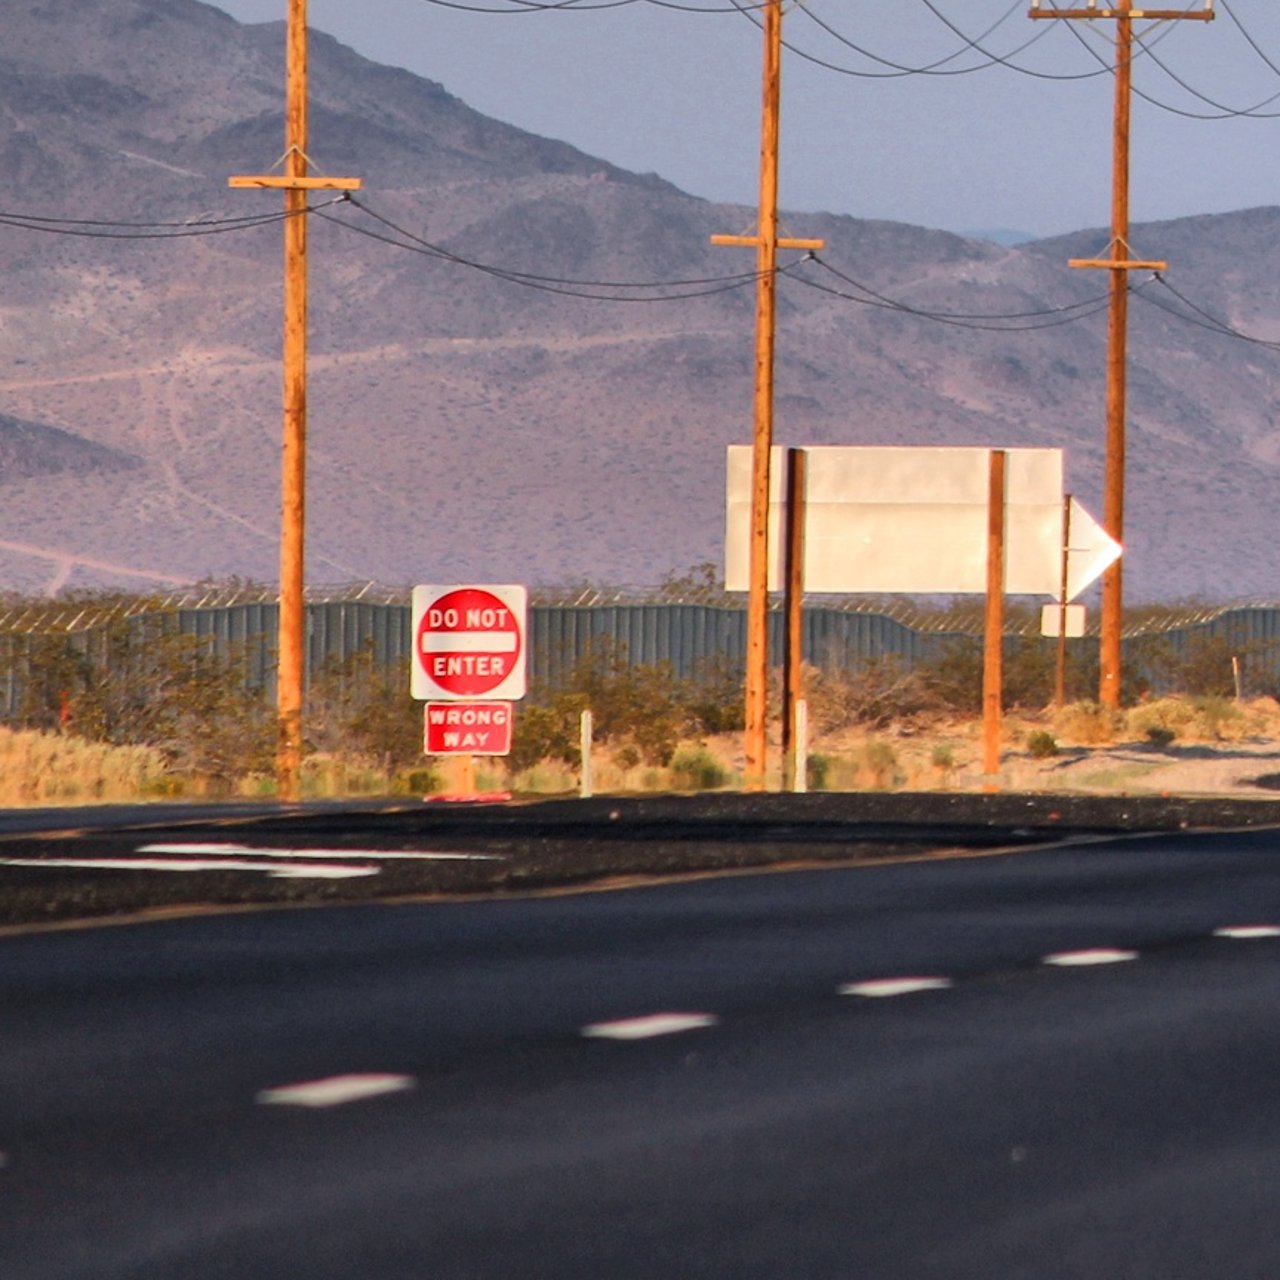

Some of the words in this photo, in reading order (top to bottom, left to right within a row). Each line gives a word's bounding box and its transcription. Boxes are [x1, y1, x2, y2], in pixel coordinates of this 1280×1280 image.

[429, 608, 459, 628] DO
[466, 608, 509, 628] NOT
[433, 656, 505, 677] ENTER
[429, 710, 506, 726] WRONG
[443, 732, 490, 748] WAY
